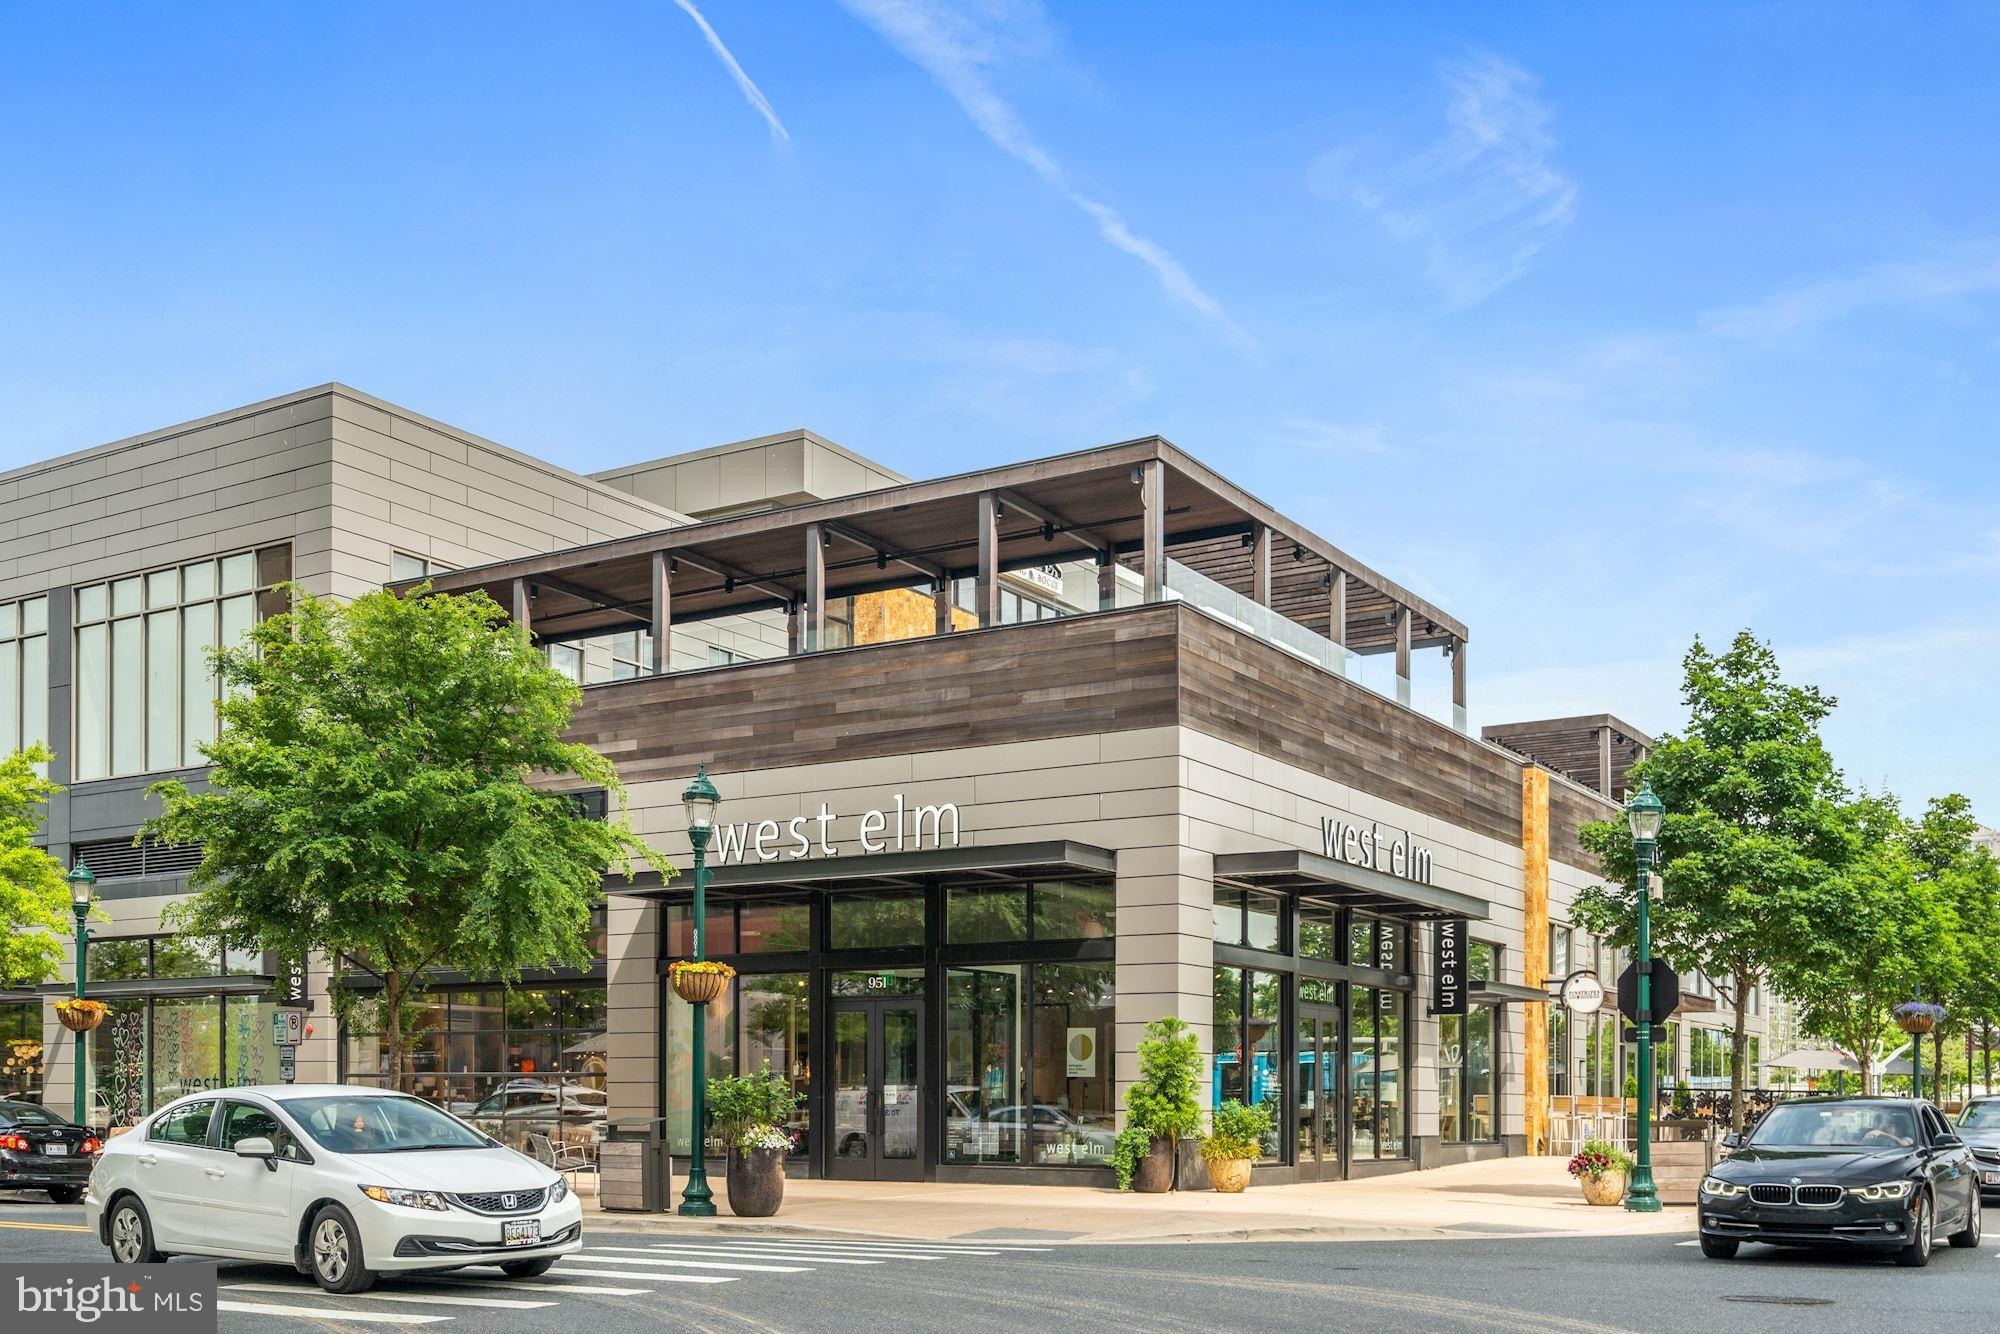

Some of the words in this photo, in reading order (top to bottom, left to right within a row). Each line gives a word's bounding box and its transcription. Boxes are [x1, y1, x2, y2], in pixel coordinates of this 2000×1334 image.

[714, 803, 838, 864] west
[860, 793, 960, 853] elm
[1321, 815, 1384, 873] west
[1390, 831, 1433, 886] elm
[1441, 923, 1458, 968] west
[287, 958, 302, 1001] west
[868, 976, 887, 989] 951
[1299, 984, 1319, 1001] west
[1319, 981, 1335, 1003] elm
[1441, 974, 1458, 1008] elm
[180, 1073, 219, 1089] west
[704, 1136, 723, 1147] elm
[1047, 1141, 1076, 1154] west
[1082, 1142, 1105, 1154] elm
